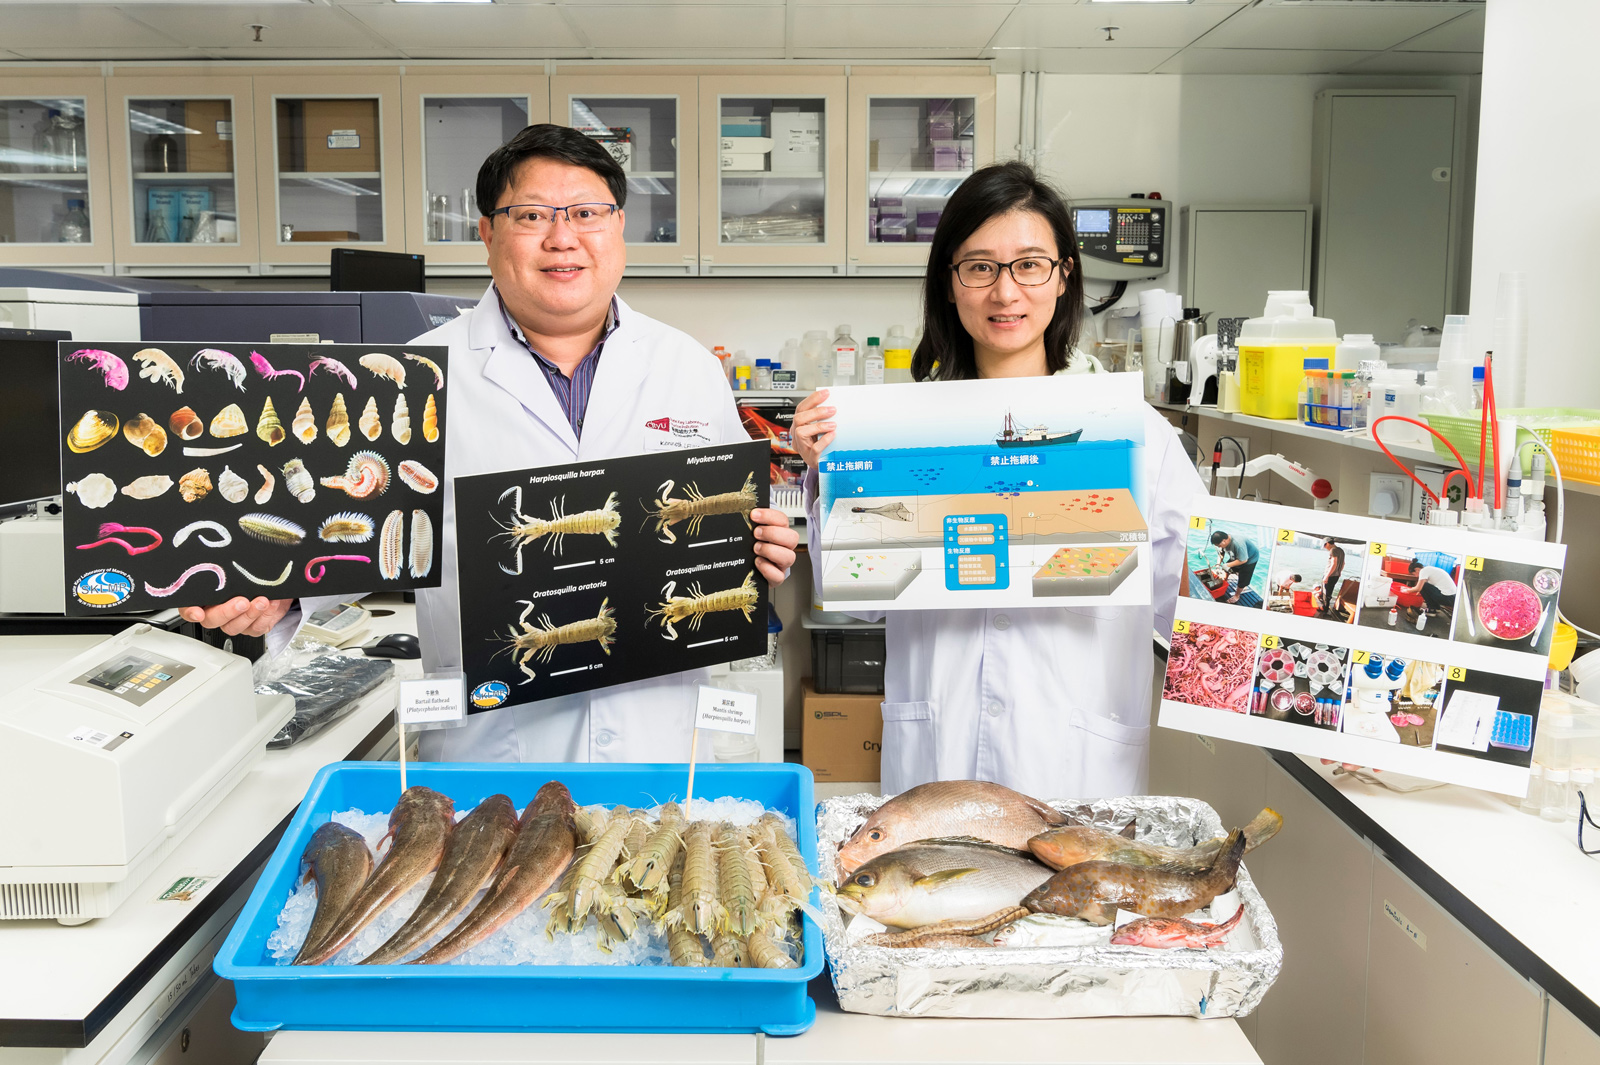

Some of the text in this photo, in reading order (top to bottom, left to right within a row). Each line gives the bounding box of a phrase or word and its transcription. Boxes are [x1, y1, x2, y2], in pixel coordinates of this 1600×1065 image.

[686, 455, 716, 465] Miyakea
[990, 454, 1039, 465] 禁止拖網後
[826, 461, 873, 471] 禁止拖網前
[530, 469, 605, 484] Harpiosquilla harpax
[1196, 518, 1200, 527] 1
[1119, 532, 1146, 541] 沉積物
[1281, 530, 1290, 540] 2
[1374, 544, 1382, 554] 3
[666, 559, 745, 577] Oratosquillina interrupta
[1470, 558, 1477, 568] 4
[80, 568, 106, 579] Laboratory
[112, 568, 127, 576] Marine
[82, 583, 127, 594] SKLMP
[532, 580, 607, 598] Oratosquilla oratoria
[1178, 621, 1184, 631] 5
[1265, 636, 1273, 646] 6
[1358, 651, 1365, 661] 7
[1452, 668, 1460, 678] 8
